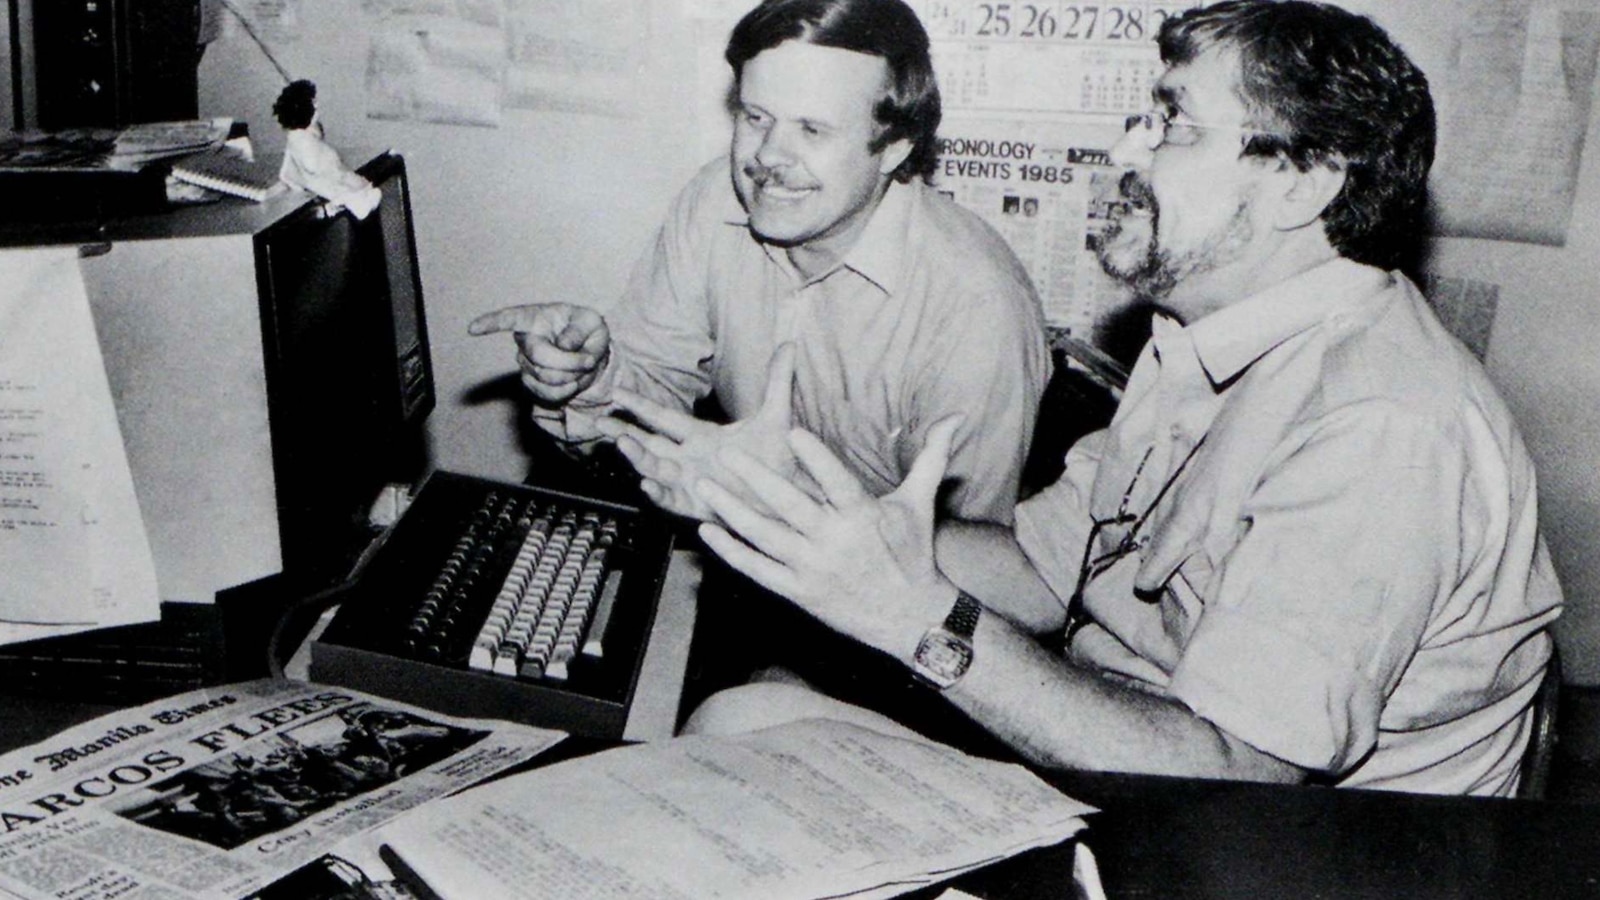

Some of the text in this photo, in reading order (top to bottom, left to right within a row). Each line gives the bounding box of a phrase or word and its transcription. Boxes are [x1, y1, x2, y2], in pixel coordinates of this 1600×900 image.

[977, 4, 1010, 36] 25
[1020, 5, 1056, 38] 26
[1063, 6, 1098, 39] 27
[1106, 7, 1143, 39] 28
[945, 160, 1011, 180] EVENTS
[1018, 164, 1073, 184] 1985
[33, 722, 154, 771] Manila
[151, 694, 237, 725] Times
[0, 692, 353, 832] ARCOS FLEES
